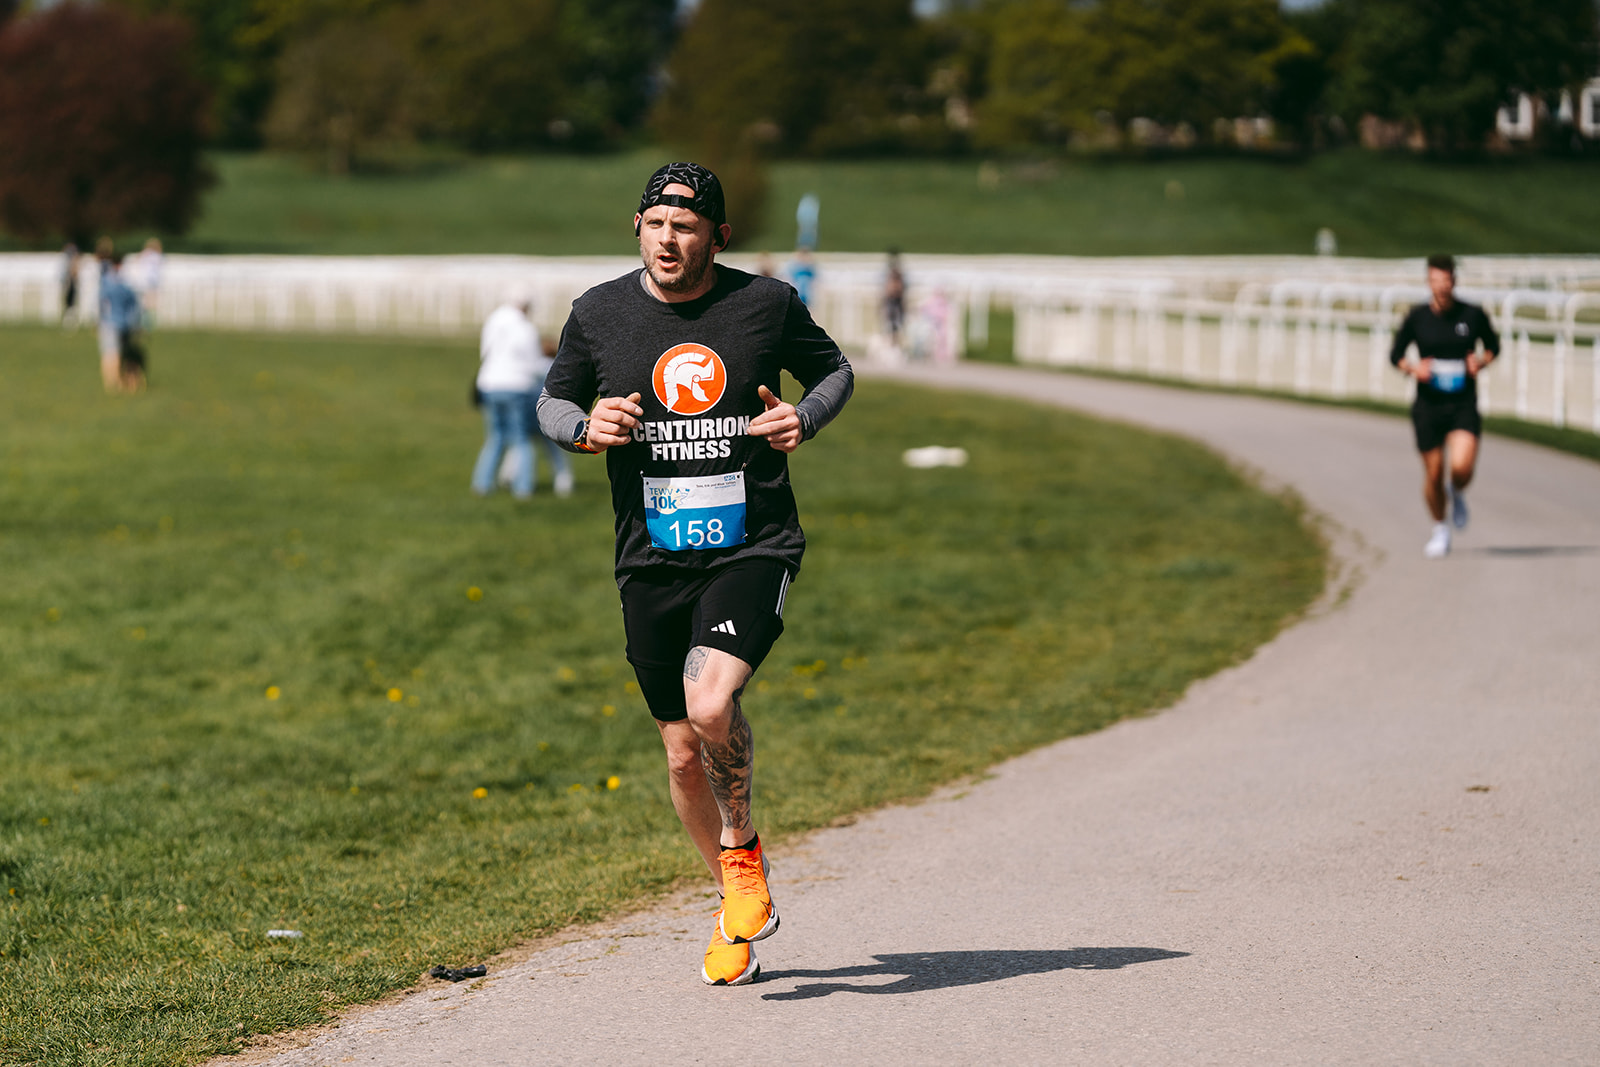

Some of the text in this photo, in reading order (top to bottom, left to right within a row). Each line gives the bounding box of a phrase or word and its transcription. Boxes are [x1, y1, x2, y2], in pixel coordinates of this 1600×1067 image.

[633, 415, 750, 443] CENTURION
[651, 439, 731, 461] FITNESS
[649, 487, 673, 496] TEWV
[650, 495, 677, 510] 10k
[668, 518, 725, 547] 158
